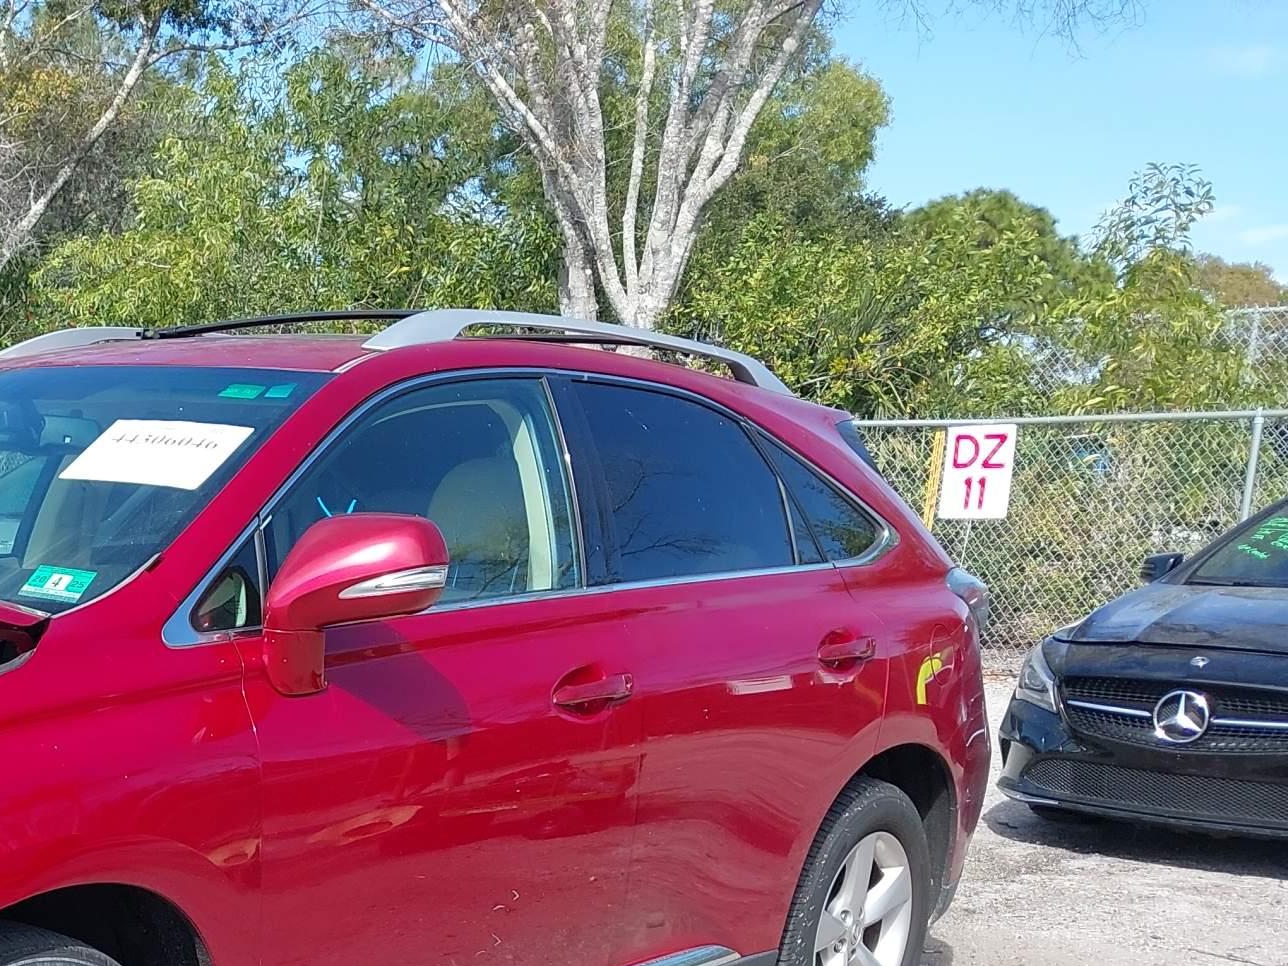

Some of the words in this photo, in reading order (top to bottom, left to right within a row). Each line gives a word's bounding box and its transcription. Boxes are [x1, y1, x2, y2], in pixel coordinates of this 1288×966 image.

[953, 434, 1007, 468] DZ
[964, 477, 986, 509] 11
[52, 577, 62, 587] 4
